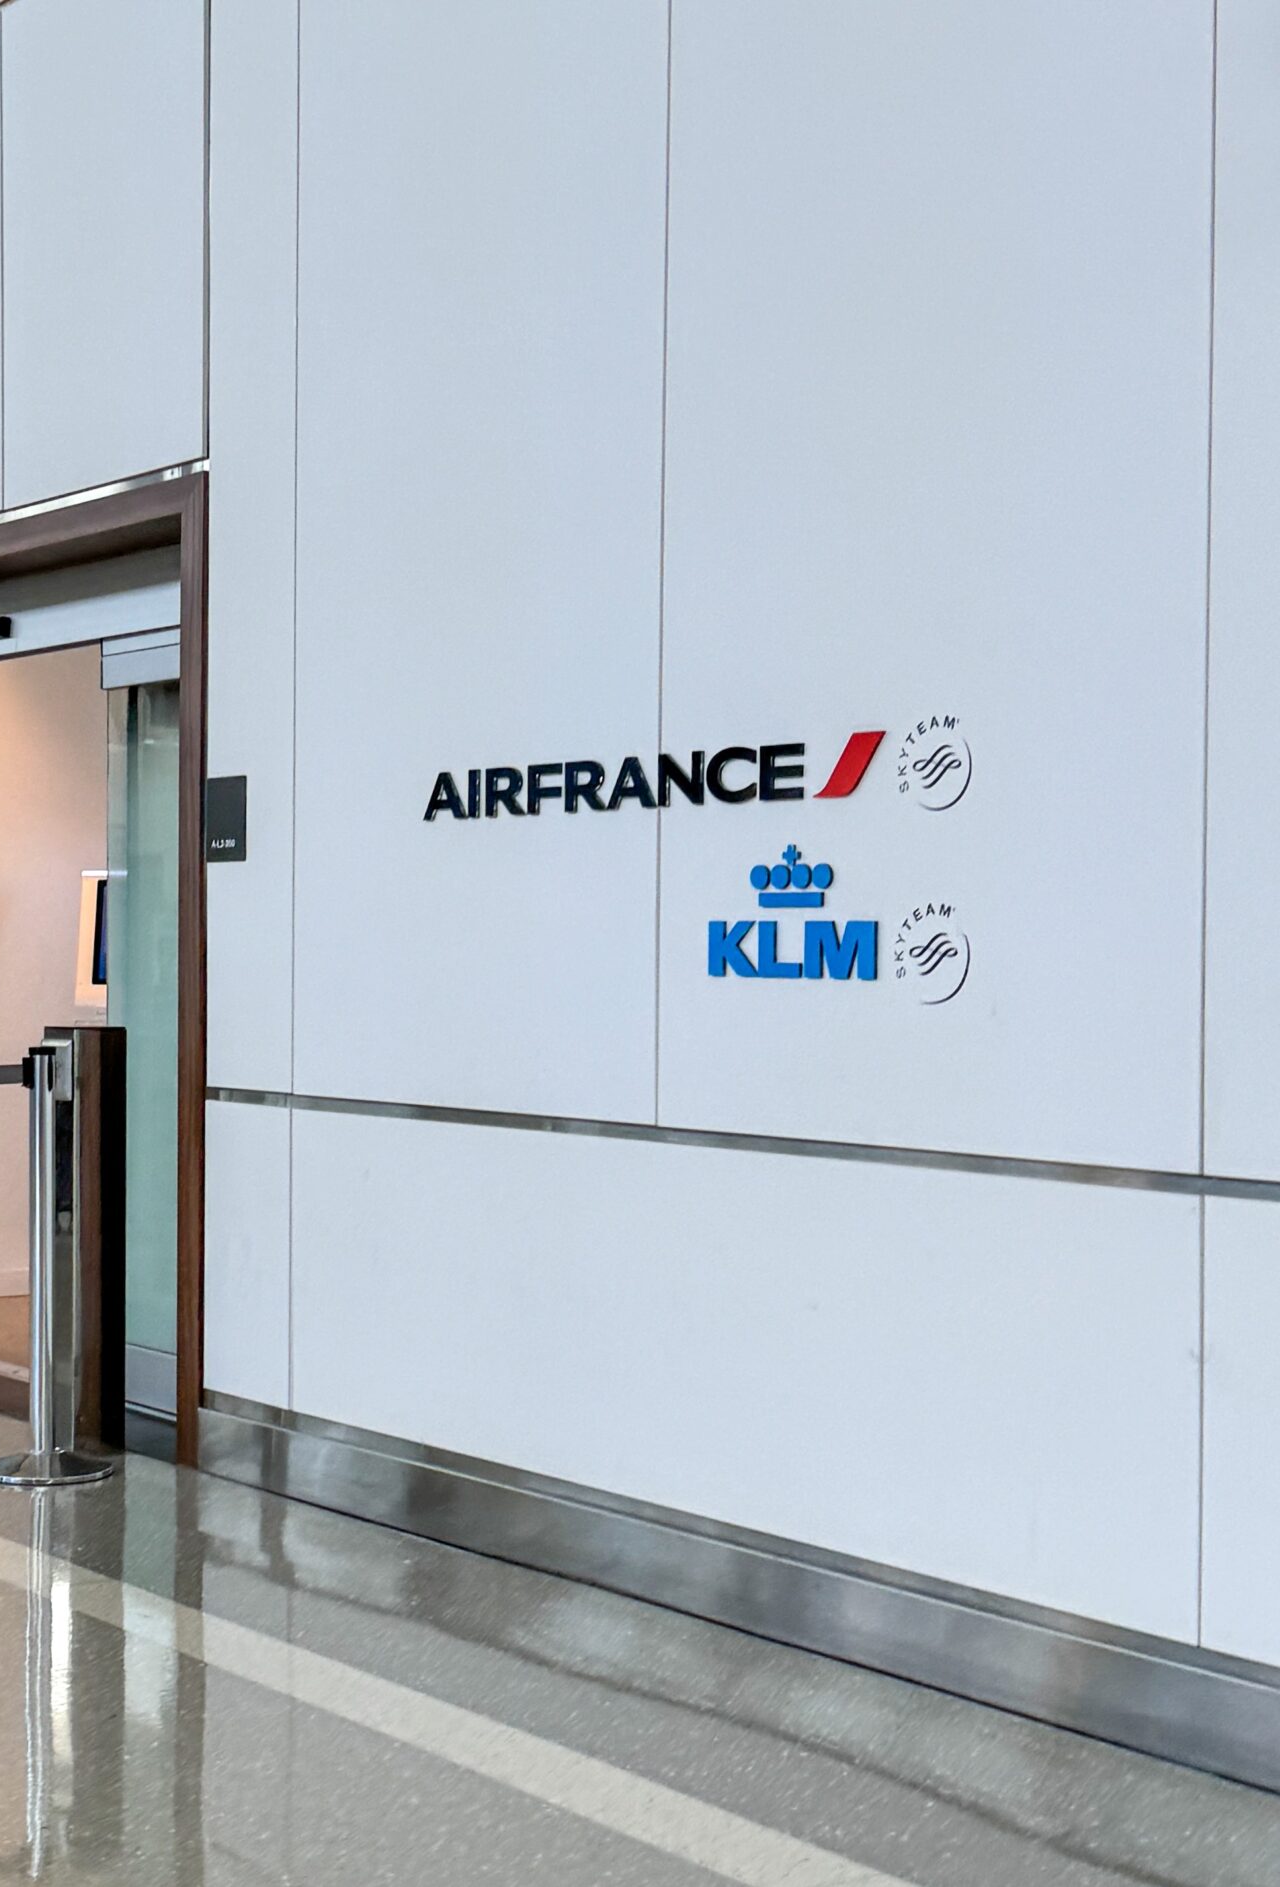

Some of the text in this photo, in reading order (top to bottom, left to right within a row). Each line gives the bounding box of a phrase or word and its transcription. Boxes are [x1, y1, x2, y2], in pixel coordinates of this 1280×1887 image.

[423, 743, 805, 821] AIRFRANCE
[897, 714, 956, 794] SKYTEAM
[708, 920, 878, 980] KLM
[893, 902, 952, 979] SKYTEAM
